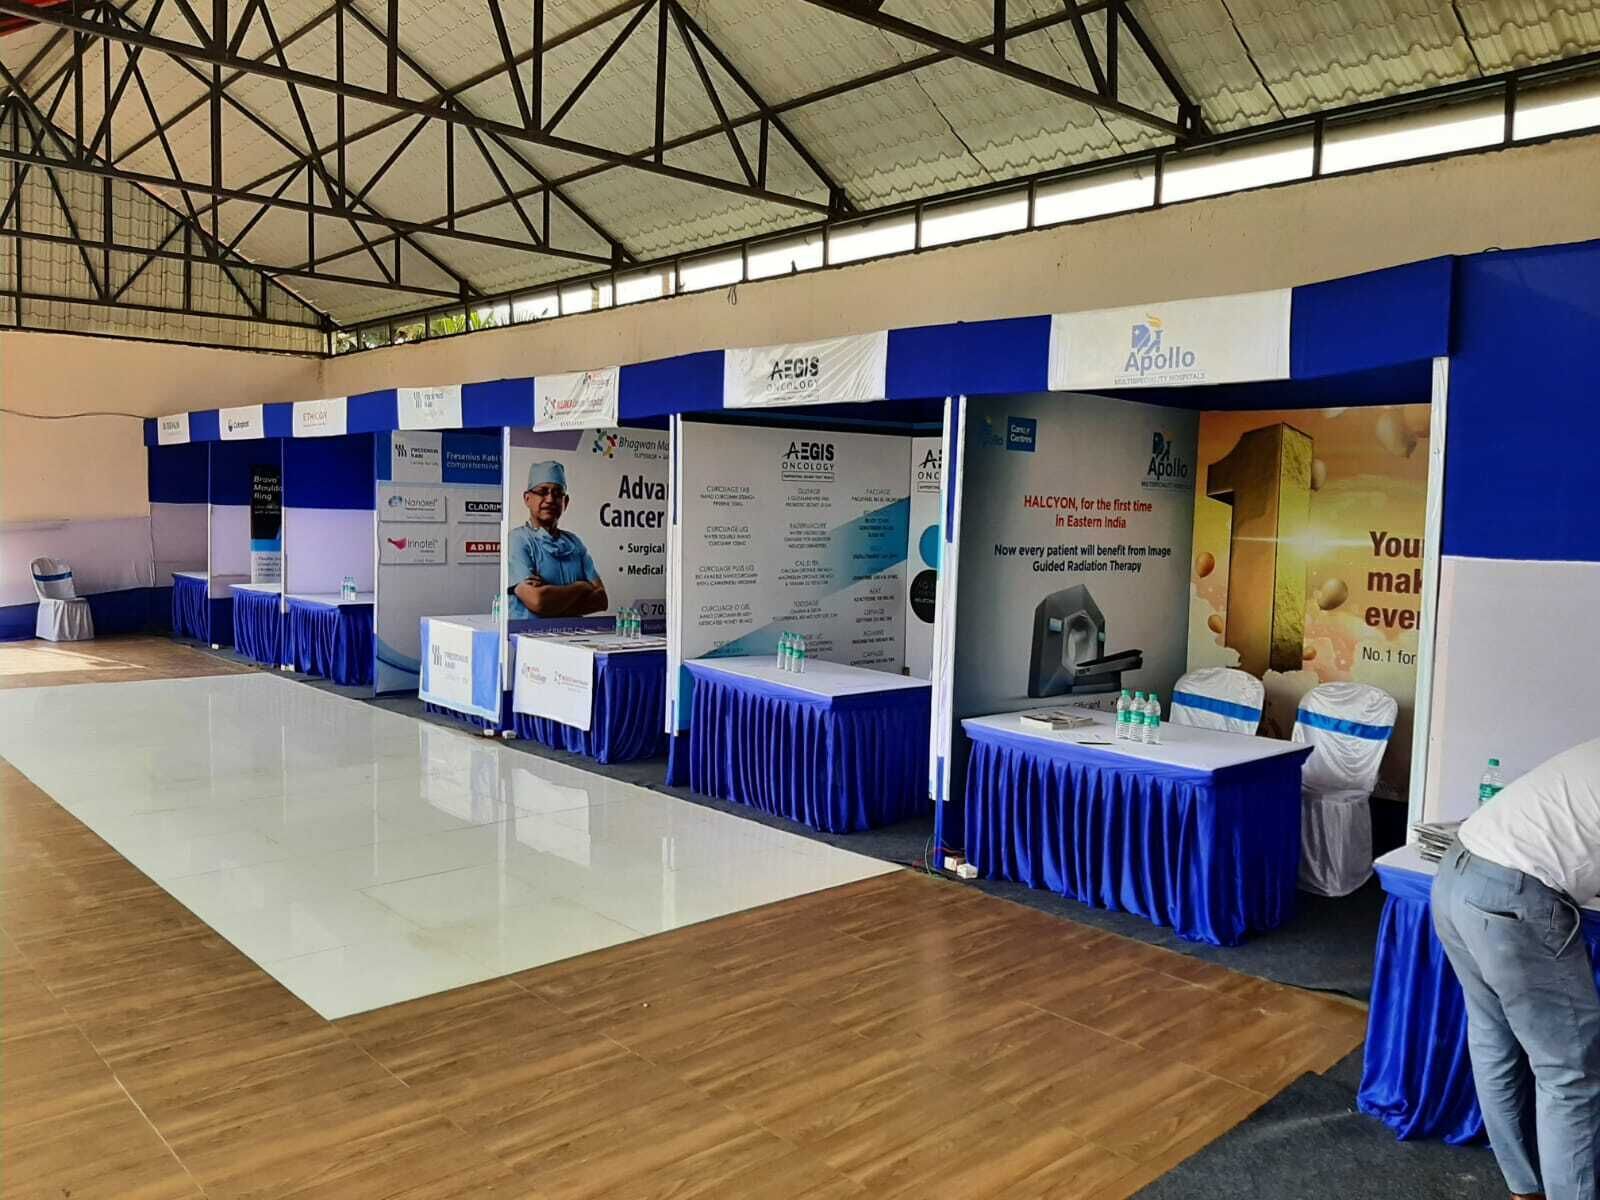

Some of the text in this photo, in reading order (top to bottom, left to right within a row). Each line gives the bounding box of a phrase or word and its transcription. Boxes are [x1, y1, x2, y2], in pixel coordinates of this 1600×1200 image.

[768, 356, 820, 381] AEGIS
[1124, 347, 1195, 376] Apollo
[619, 436, 656, 451] Bhagwan
[782, 441, 835, 461] AEGIS
[446, 452, 481, 461] Fresenius
[446, 462, 499, 470] comprehensive
[782, 462, 835, 471] ONCOLOGY
[1147, 457, 1189, 480] Apollo
[618, 475, 669, 501] Adva
[1023, 495, 1153, 512] HALCYON, for the first time
[600, 503, 665, 529] Cancer
[1055, 514, 1127, 528] in Eastern India
[627, 543, 665, 556] Surgical
[994, 543, 1172, 558] Now every patient will benefit from Image
[1369, 531, 1425, 558] You
[627, 564, 664, 577] Medical
[1032, 560, 1142, 573] Guided Radiation Therapy
[650, 604, 665, 616] 70
[1398, 650, 1417, 665] for
